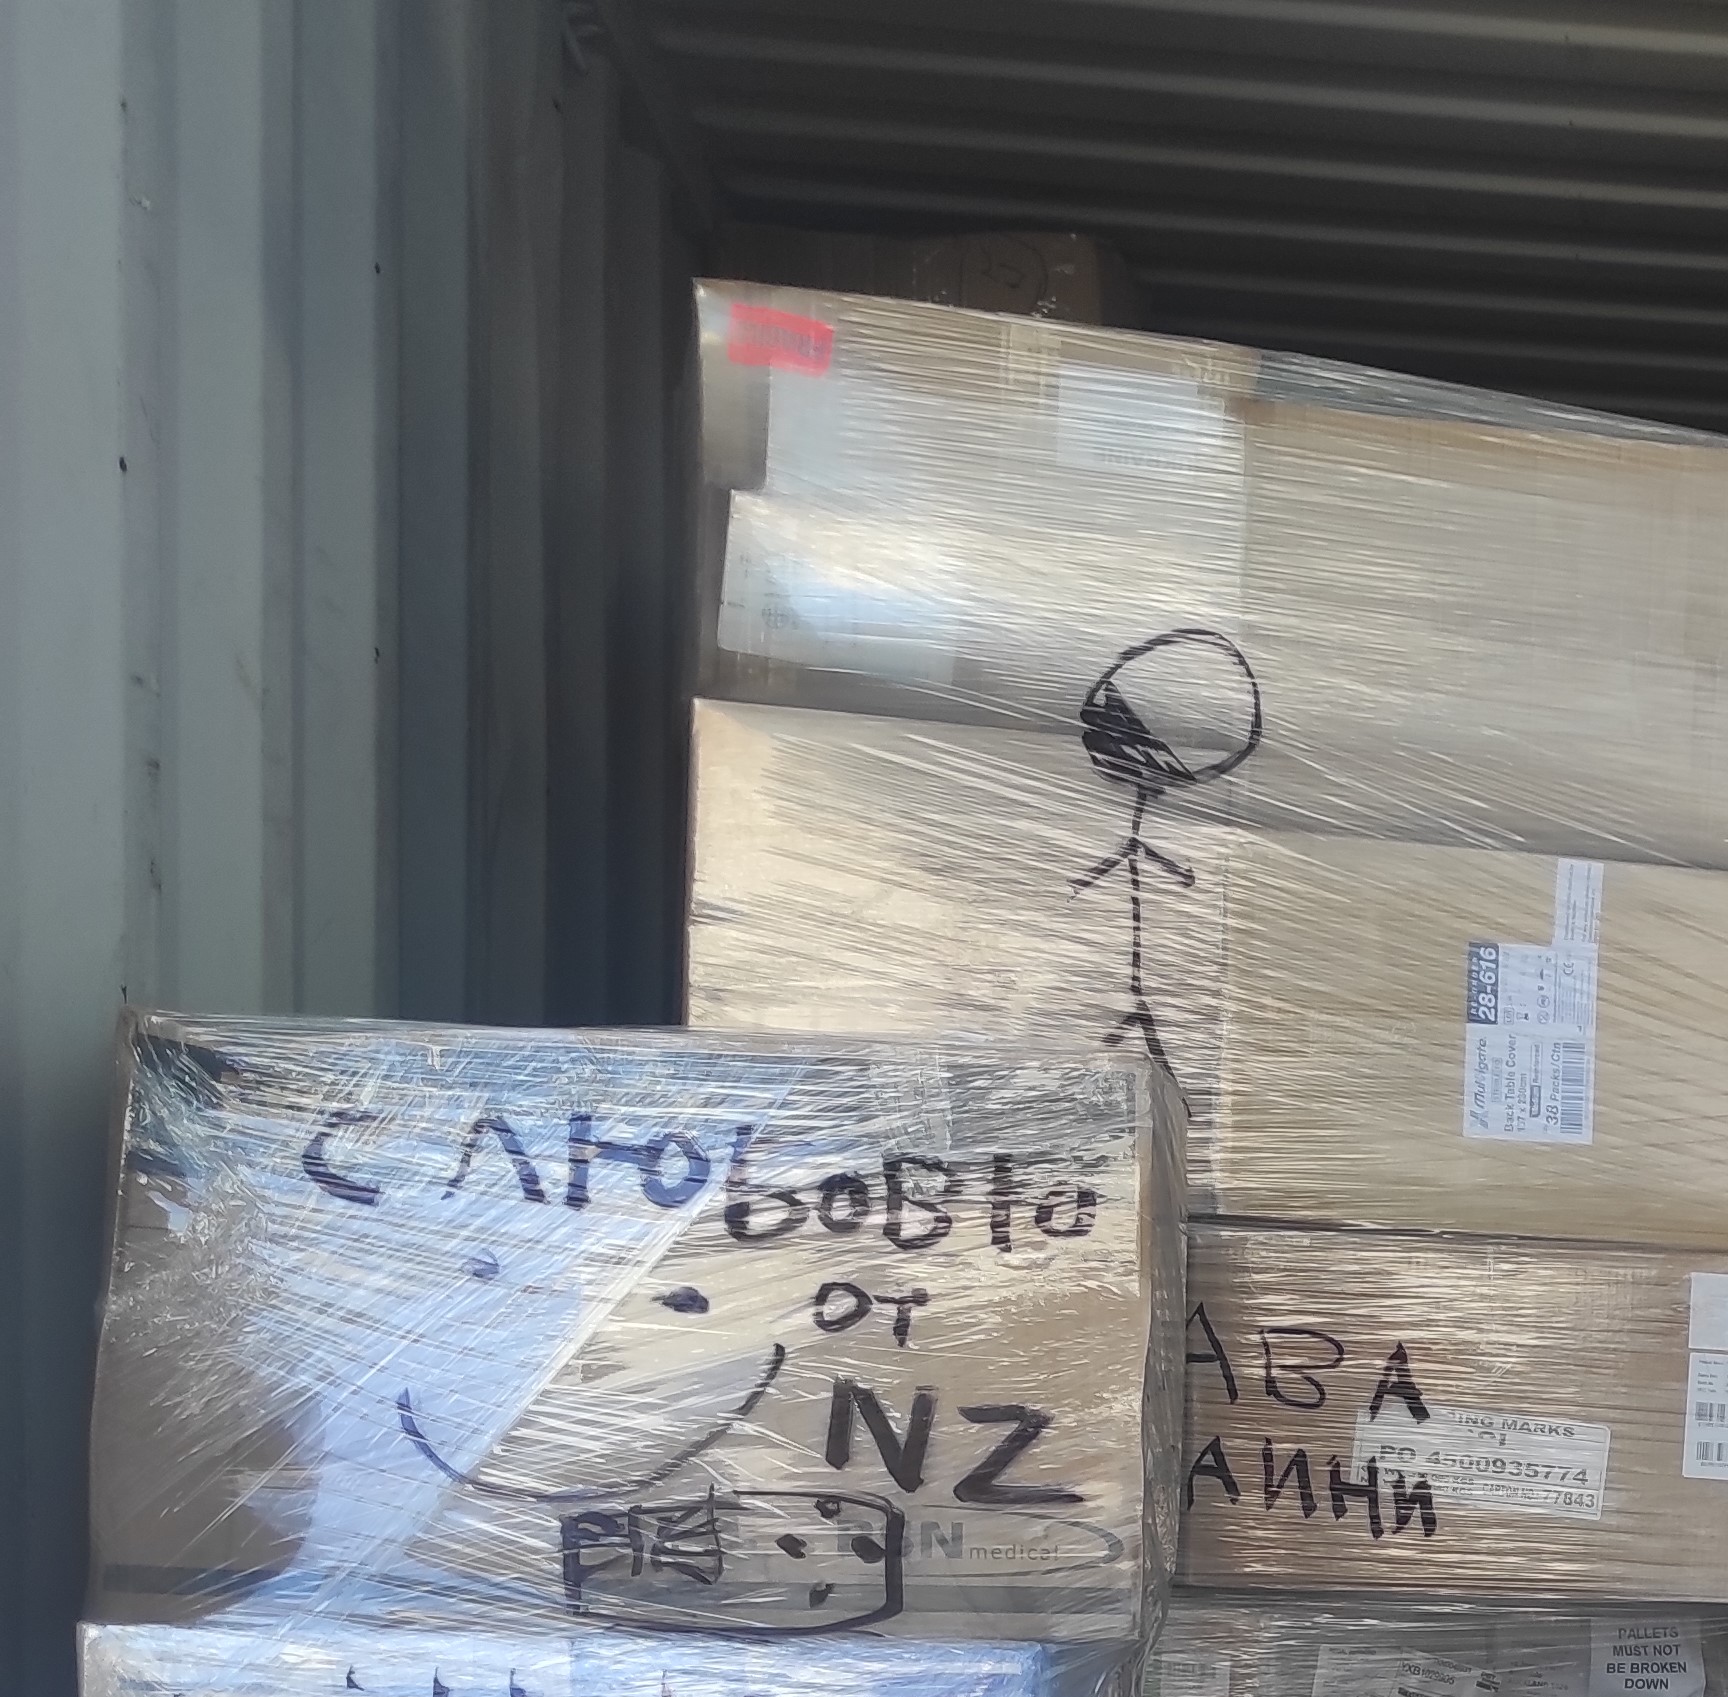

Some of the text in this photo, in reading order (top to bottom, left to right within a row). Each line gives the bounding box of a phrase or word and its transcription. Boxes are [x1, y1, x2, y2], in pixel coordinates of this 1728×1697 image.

[1478, 946, 1497, 1022] 28-616
[1505, 1033, 1517, 1068] Cover
[1504, 1071, 1516, 1100] Table
[1501, 1418, 1576, 1438] MARKS
[824, 1376, 1088, 1503] NZ
[969, 1544, 1060, 1562] medical
[1617, 1626, 1680, 1641] PALLETS
[1611, 1643, 1682, 1658] MUST NOT
[1605, 1661, 1688, 1675] BE BROKEN
[1623, 1677, 1670, 1691] DOWN
